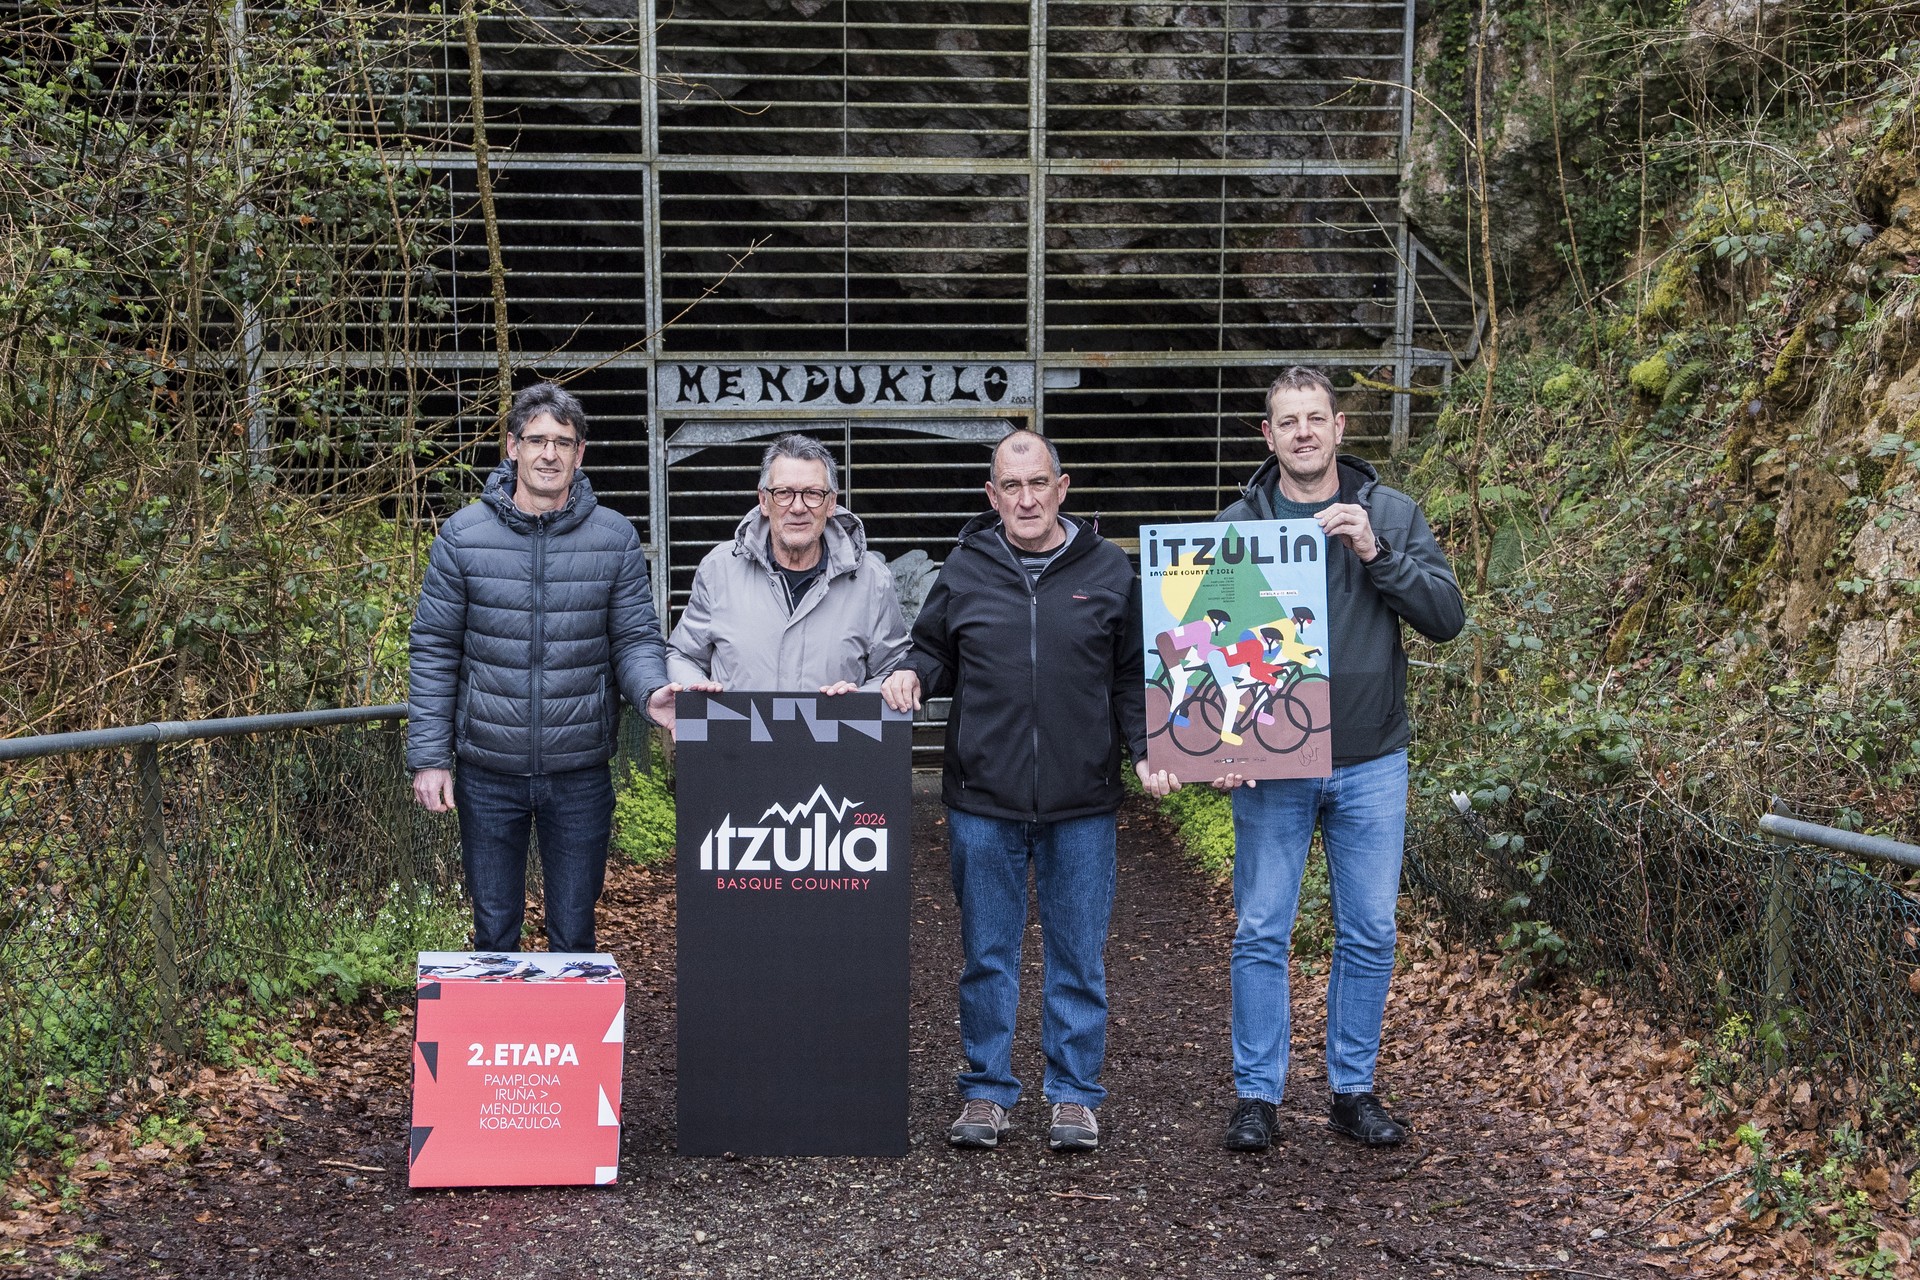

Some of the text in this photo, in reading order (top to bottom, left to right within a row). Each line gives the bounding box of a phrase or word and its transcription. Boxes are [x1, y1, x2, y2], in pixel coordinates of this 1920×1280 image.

[853, 812, 887, 826] 2026
[717, 877, 871, 890] BASQUE COUNTRY
[467, 1042, 579, 1066] 2.ETAPA
[484, 1073, 561, 1086] PAMPLONA
[495, 1085, 537, 1101] IRUÑA
[480, 1102, 562, 1115] MENDUKILO
[479, 1117, 562, 1129] KOBAZULOA
